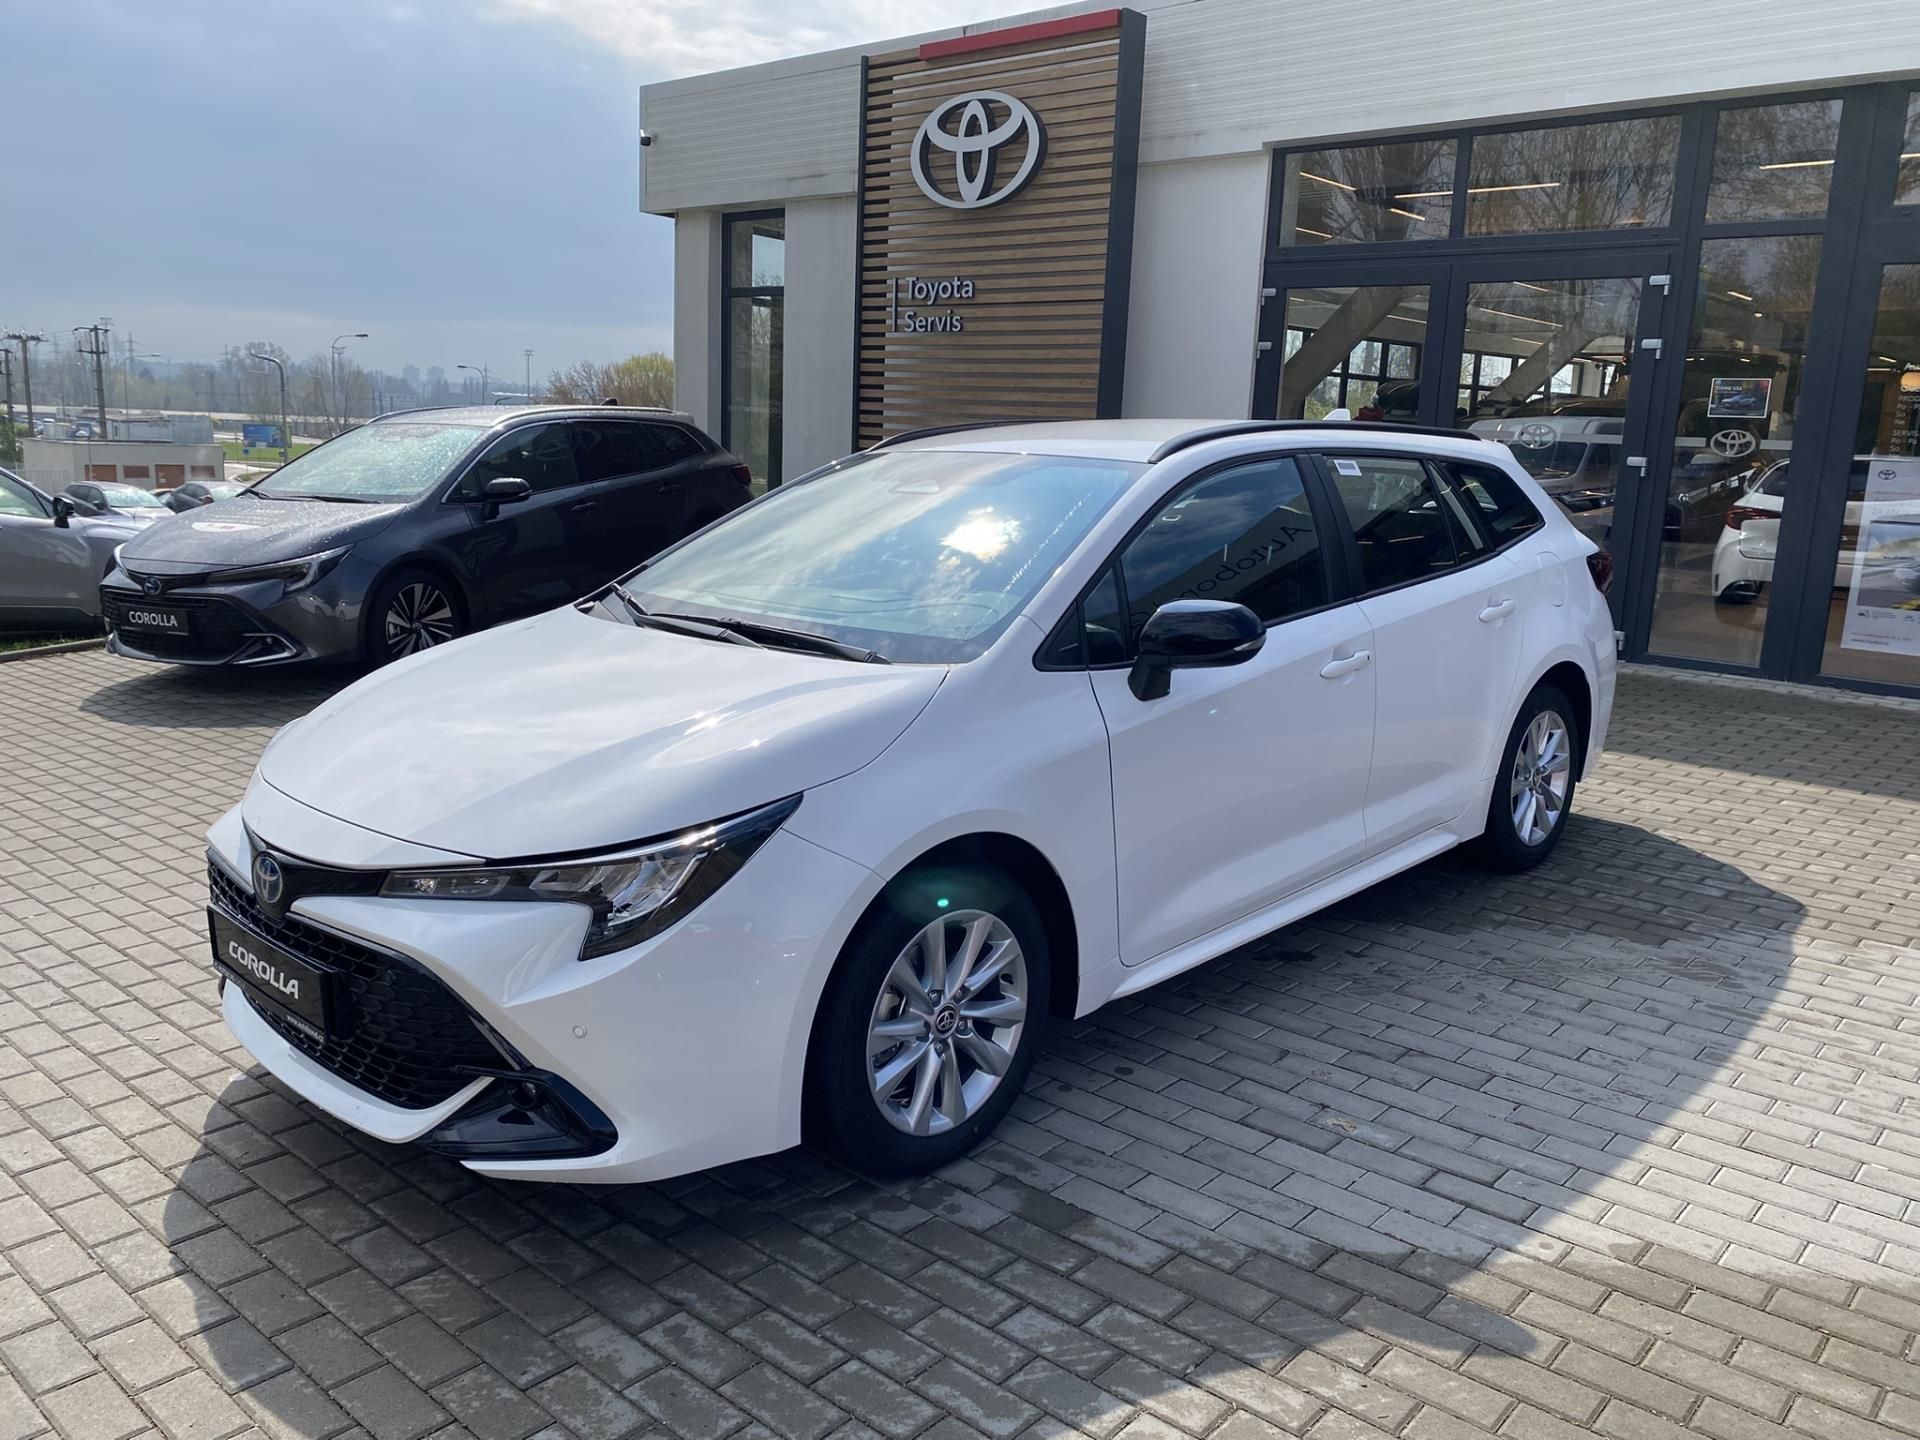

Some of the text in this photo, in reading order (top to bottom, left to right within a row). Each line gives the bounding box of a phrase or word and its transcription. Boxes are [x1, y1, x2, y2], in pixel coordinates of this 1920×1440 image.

[905, 275, 975, 305] Toyota
[904, 309, 963, 333] Servis
[128, 611, 178, 627] COROLLA
[228, 941, 299, 1000] COROLLA
